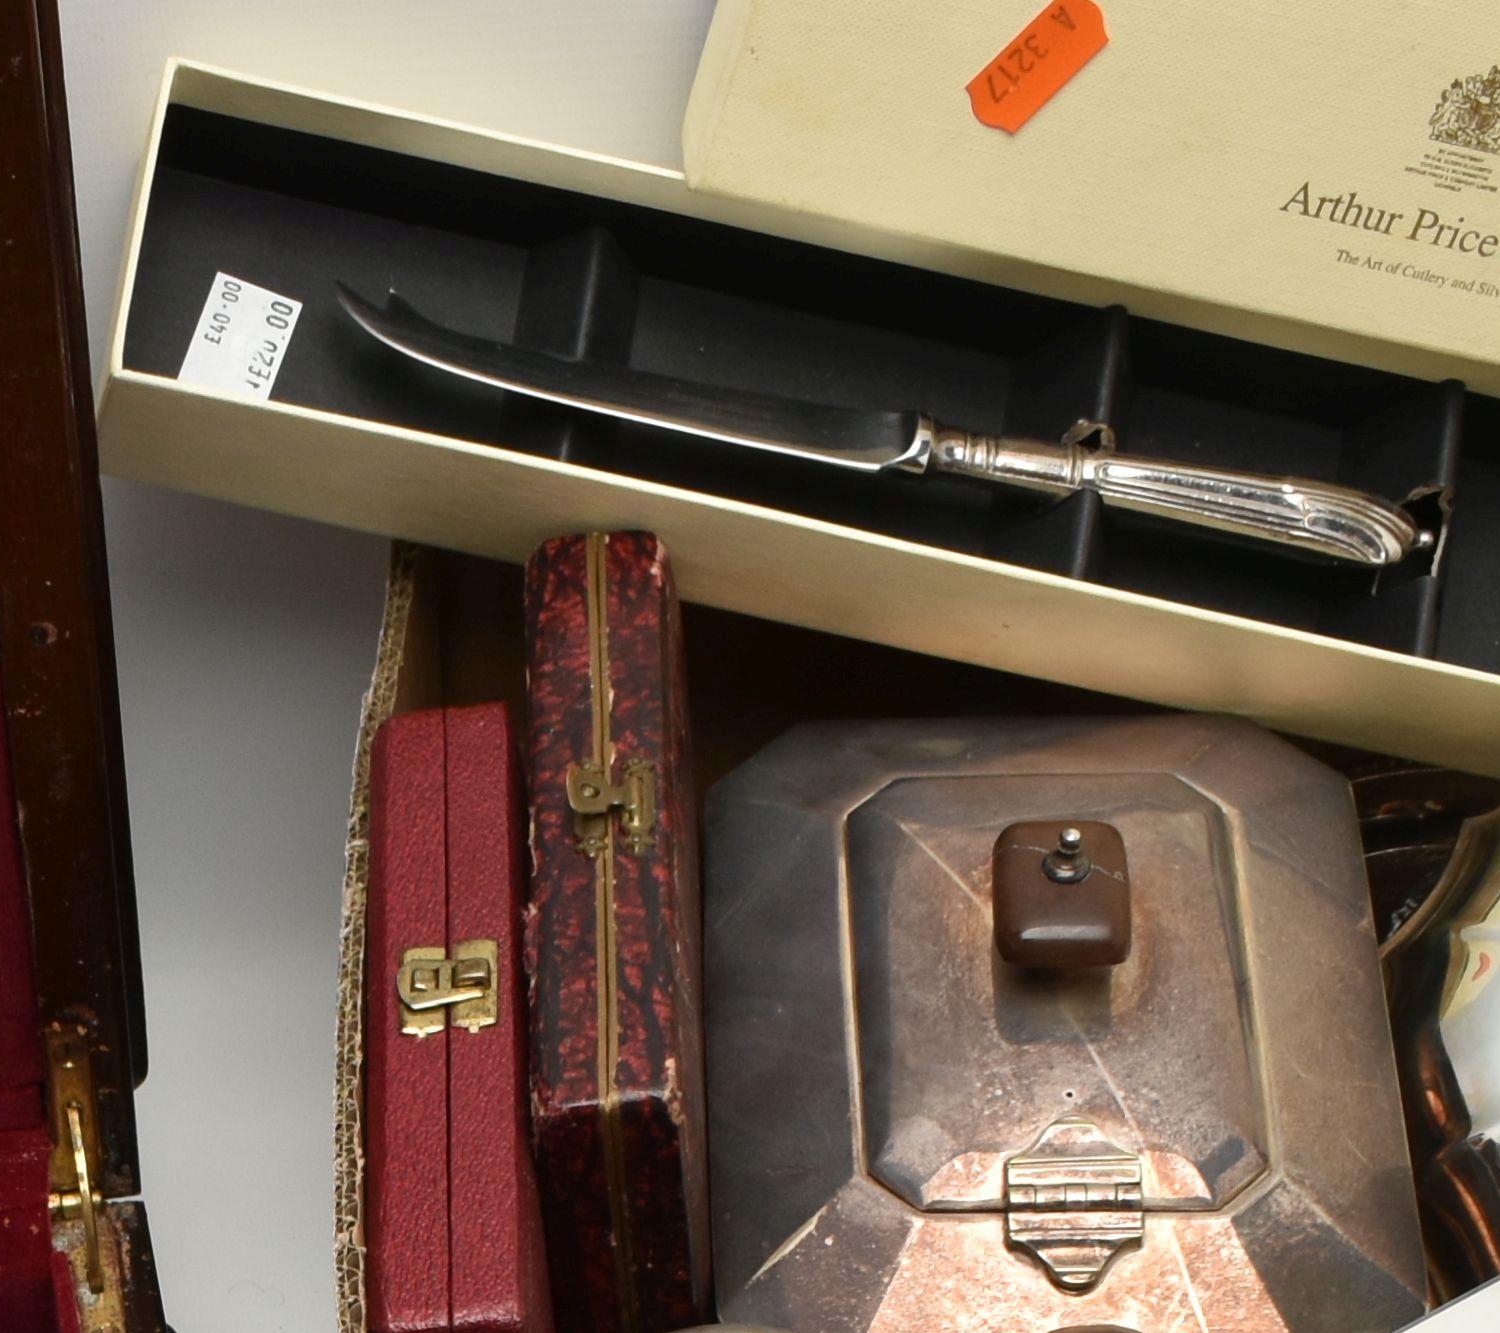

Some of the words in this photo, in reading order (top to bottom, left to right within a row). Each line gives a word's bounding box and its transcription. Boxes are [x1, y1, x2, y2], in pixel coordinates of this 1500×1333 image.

[986, 33, 1049, 104] 3217
[1279, 181, 1404, 236] Arthur
[1405, 207, 1499, 258] Price
[1336, 249, 1360, 266] The
[1361, 256, 1384, 271] Art
[1385, 262, 1402, 275] of
[1402, 264, 1449, 288] Cutlery
[1451, 278, 1476, 292] and
